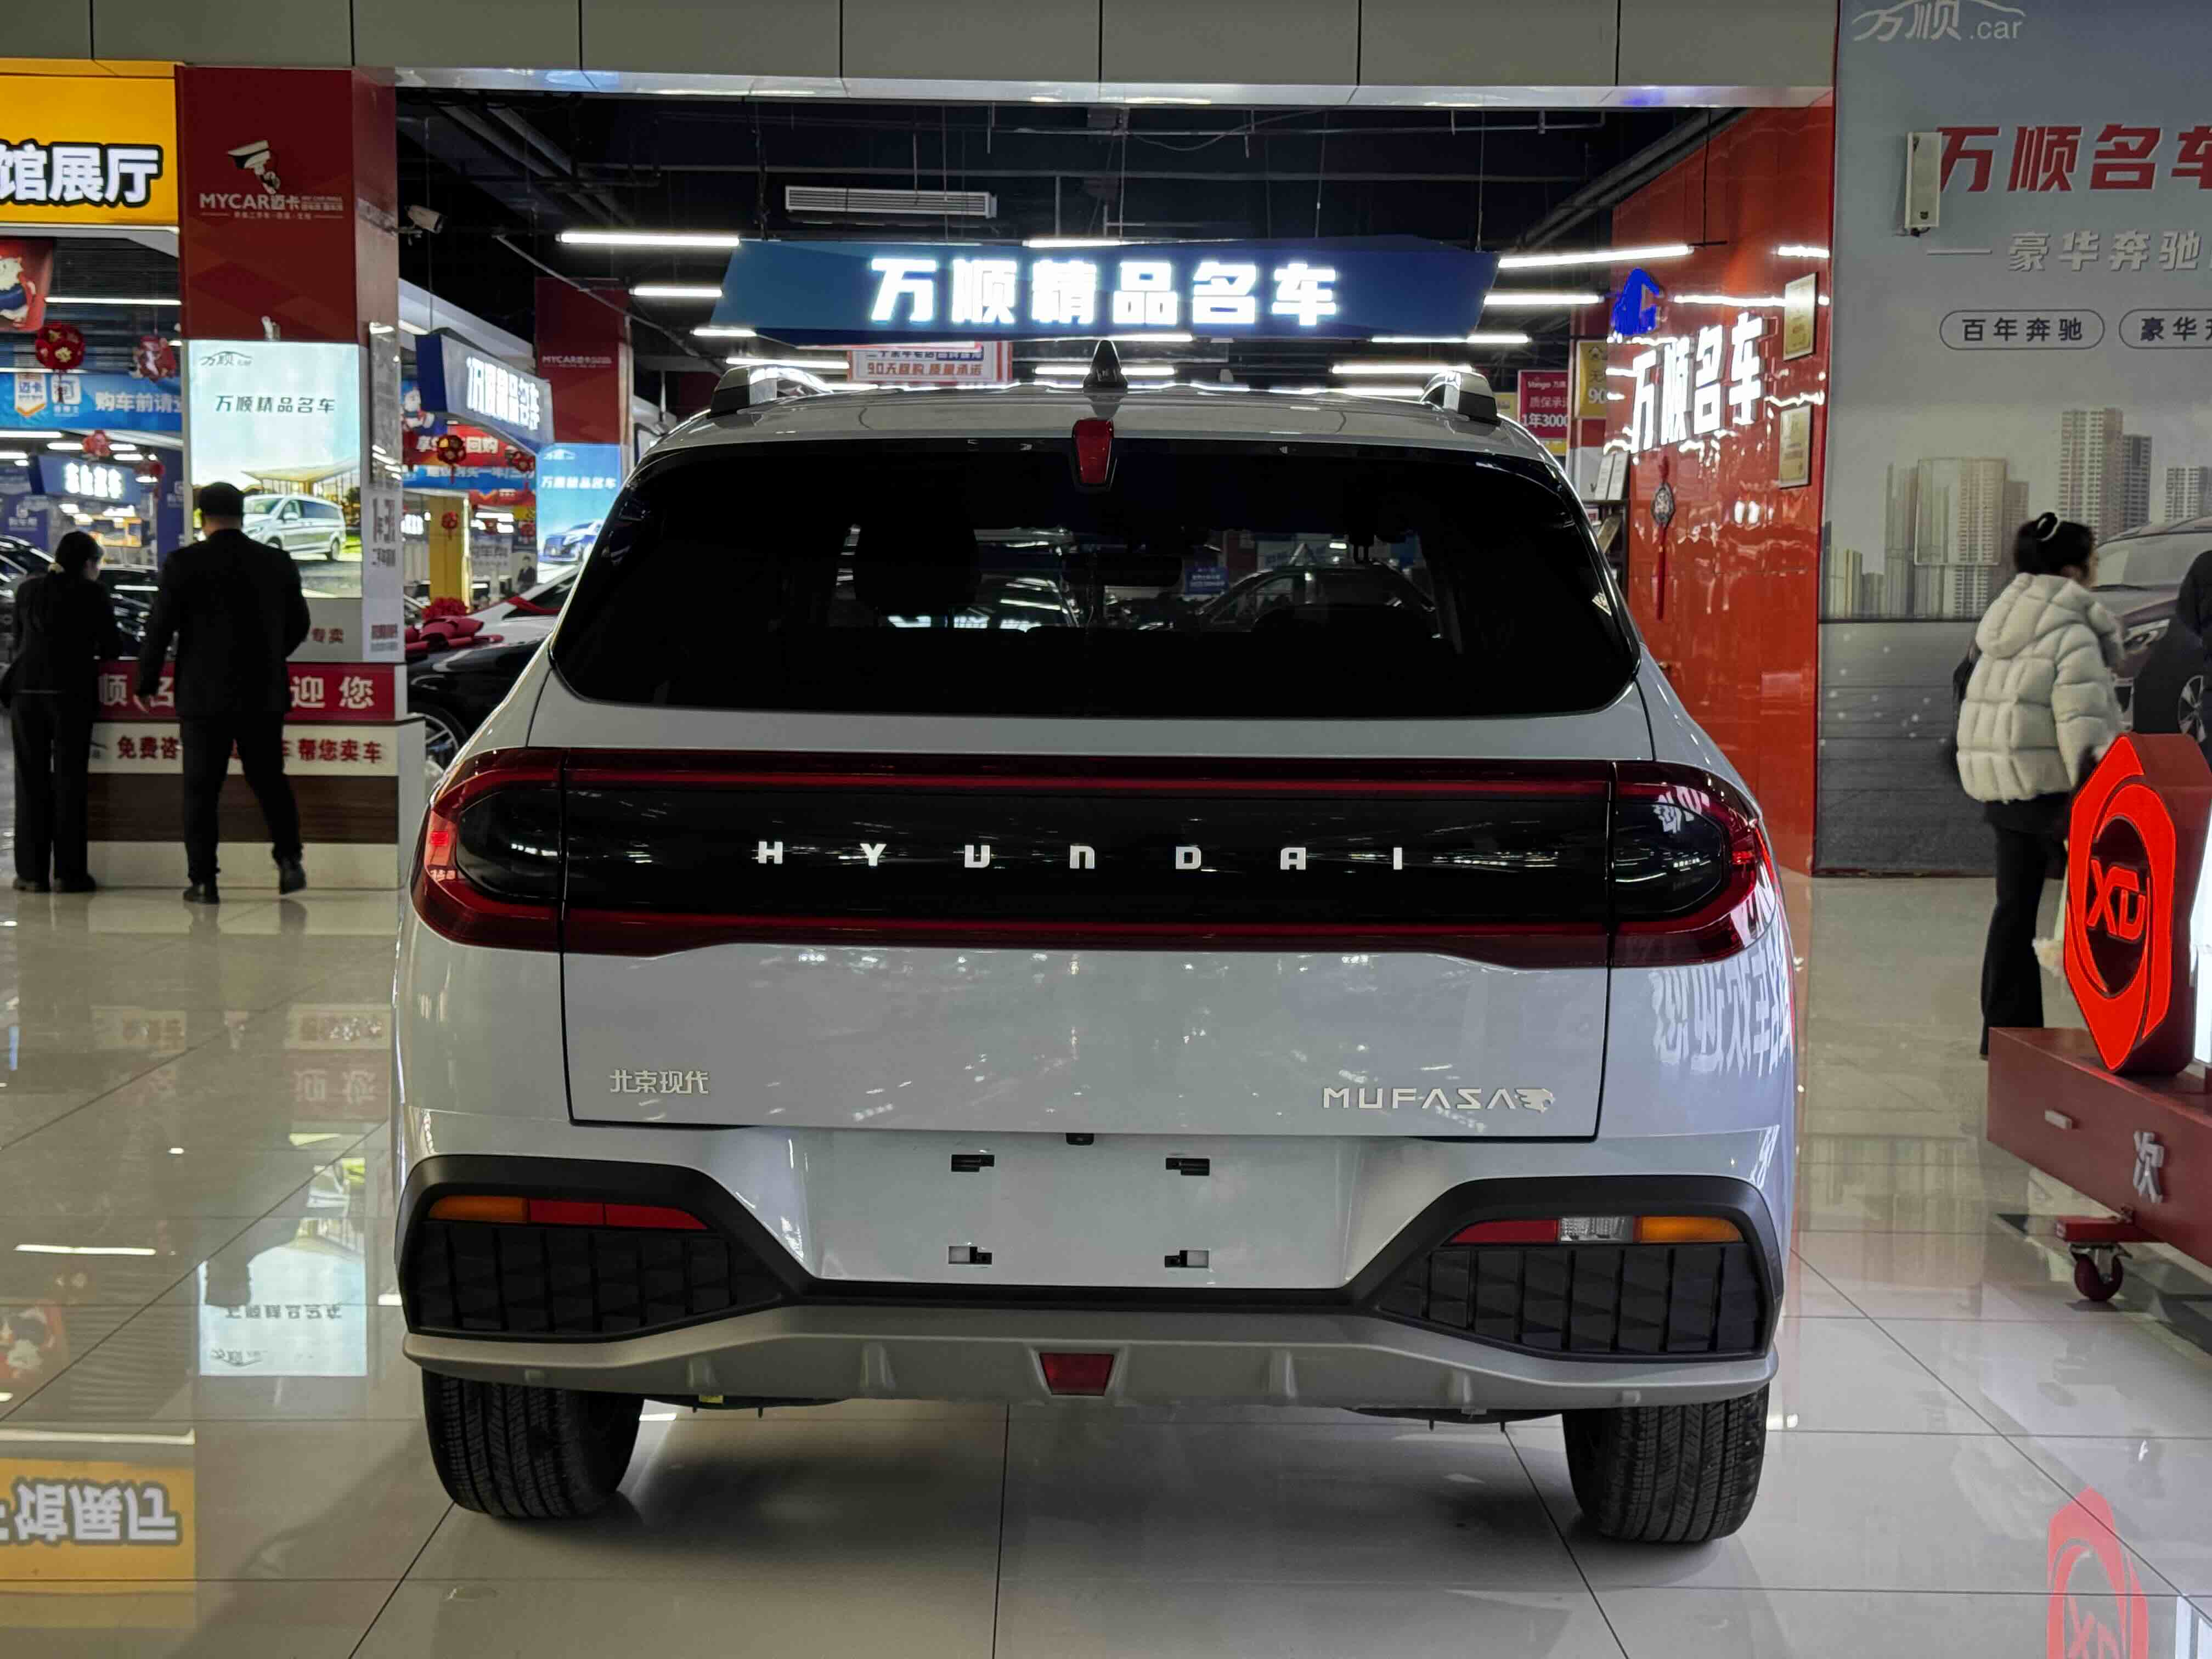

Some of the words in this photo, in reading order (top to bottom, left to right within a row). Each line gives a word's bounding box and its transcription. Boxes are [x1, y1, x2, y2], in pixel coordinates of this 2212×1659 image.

[2008, 230, 2212, 273] 豪华奔驰
[870, 258, 1338, 326] 万顺精品名车
[1962, 317, 2083, 342] 百年奔驰
[1630, 312, 1763, 454] 万顺名车
[216, 395, 336, 413] 万顺精品名车
[758, 841, 1403, 871] HYUNDAI
[610, 1069, 709, 1094] 北京现代
[1323, 1087, 1516, 1110] MUFASA
